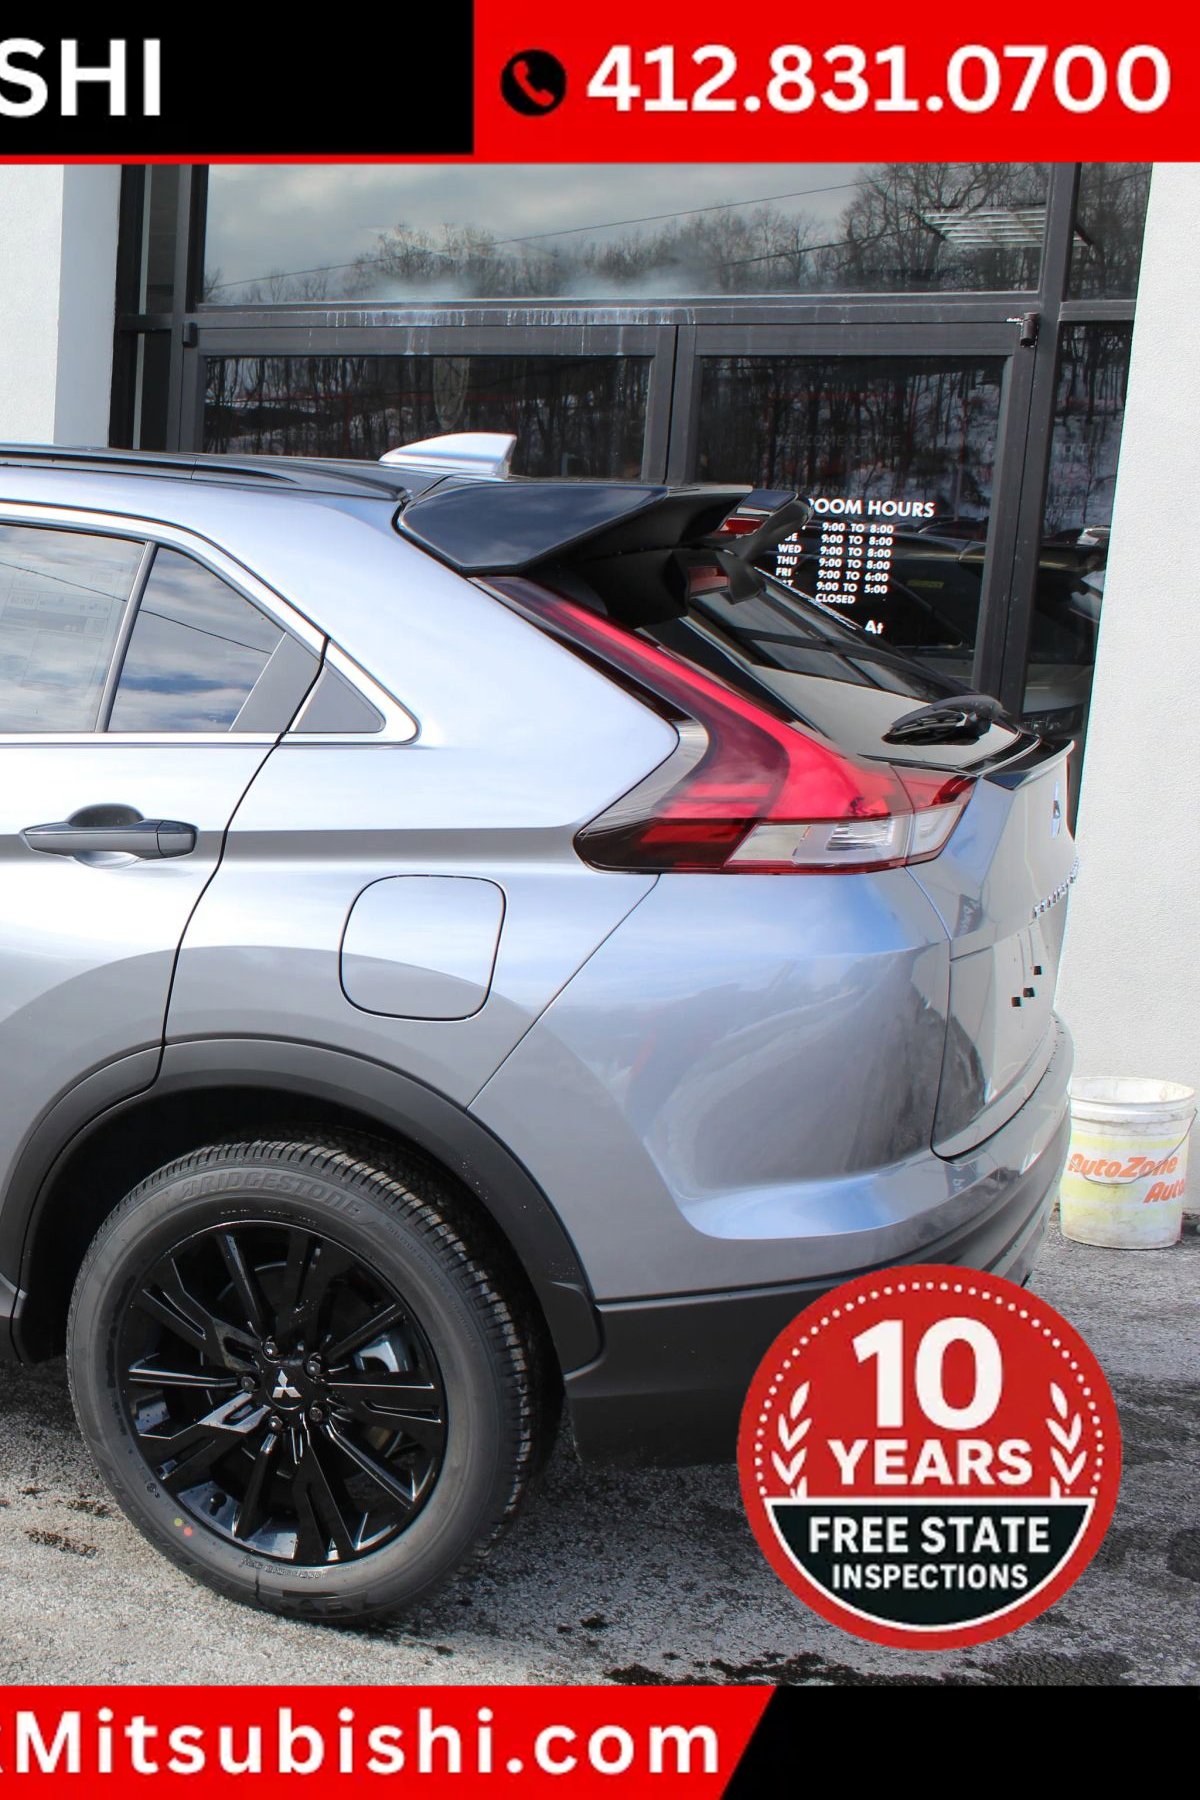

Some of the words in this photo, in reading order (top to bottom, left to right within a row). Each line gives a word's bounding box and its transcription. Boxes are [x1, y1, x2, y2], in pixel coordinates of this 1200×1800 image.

[868, 500, 935, 518] HOURS
[822, 522, 846, 532] 9:00
[851, 523, 865, 533] TO
[870, 524, 894, 534] 8:00
[821, 534, 844, 544] 9:00
[849, 535, 863, 545] TO
[869, 536, 893, 546] 8:00
[778, 543, 802, 554] WED
[820, 546, 843, 556] 9:00
[848, 547, 863, 557] TO
[867, 548, 892, 558] 8:00
[777, 555, 798, 566] THU
[819, 558, 843, 568] 9:00
[847, 559, 862, 569] TO
[866, 560, 891, 570] 8:00
[775, 567, 792, 577] FRI
[818, 569, 841, 580] 9:00
[846, 571, 860, 581] TO
[865, 572, 889, 582] 6:00
[816, 581, 839, 592] 9:00
[843, 582, 858, 593] TO
[864, 584, 888, 594] 5:00
[815, 593, 856, 604] CLOSED
[1067, 1153, 1179, 1178] AutoZone
[181, 1170, 363, 1217] BRIDGESTONE
